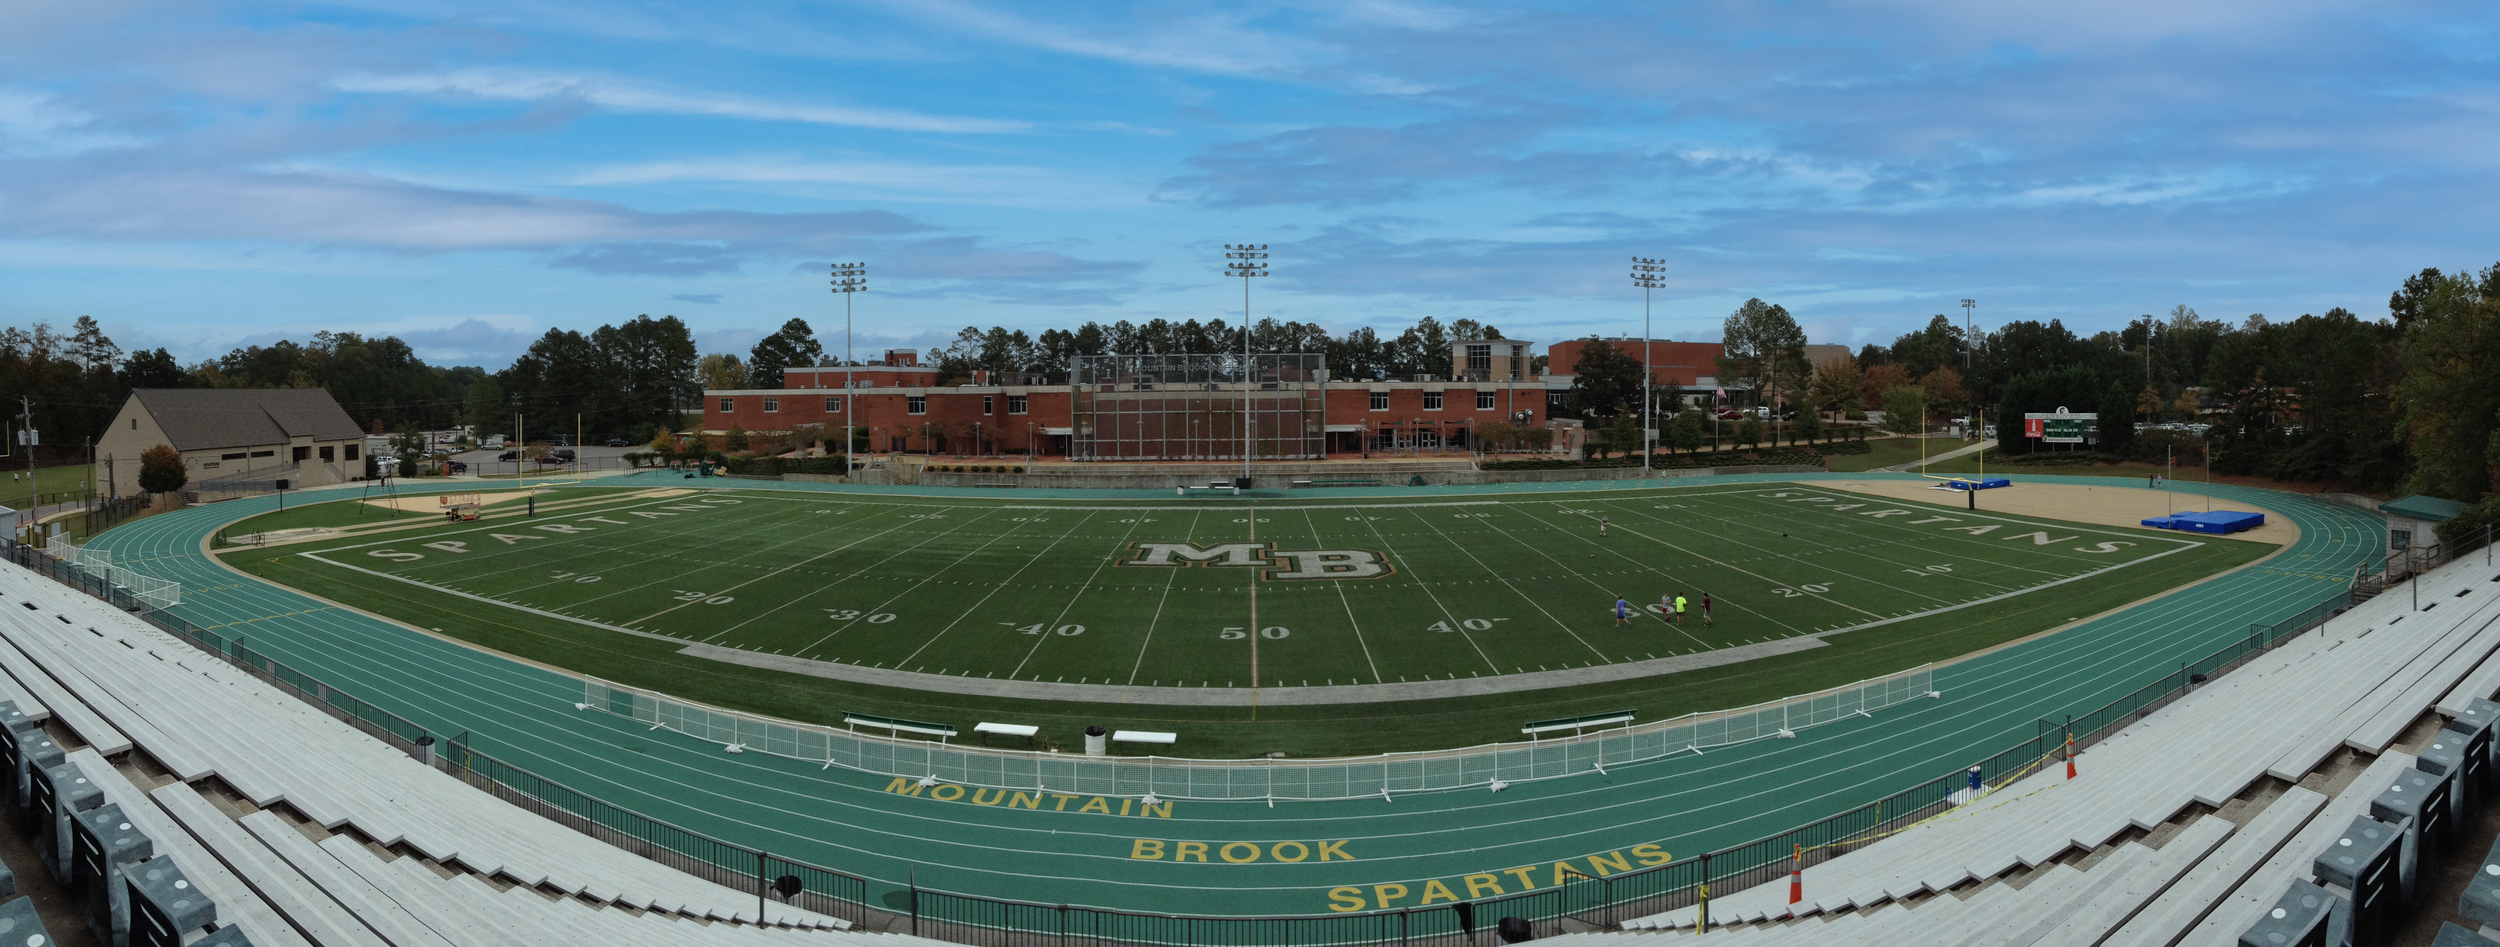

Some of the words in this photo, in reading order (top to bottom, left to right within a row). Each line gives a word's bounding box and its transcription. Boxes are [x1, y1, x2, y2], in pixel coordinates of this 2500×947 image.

[366, 498, 743, 562] SPARTANS
[1757, 492, 2138, 554] SPARTANS
[549, 571, 602, 583] 10
[1901, 565, 1953, 577] 10
[673, 591, 734, 605] 20
[1771, 583, 1830, 598] 20
[829, 609, 897, 624] 30
[1015, 623, 1086, 636] 40
[1219, 626, 1290, 640] 50
[1426, 618, 1493, 633] 40
[884, 777, 1174, 818] MOUNTAIN
[1131, 838, 1356, 864] BROOK
[1328, 842, 1673, 912] SPARTANS
